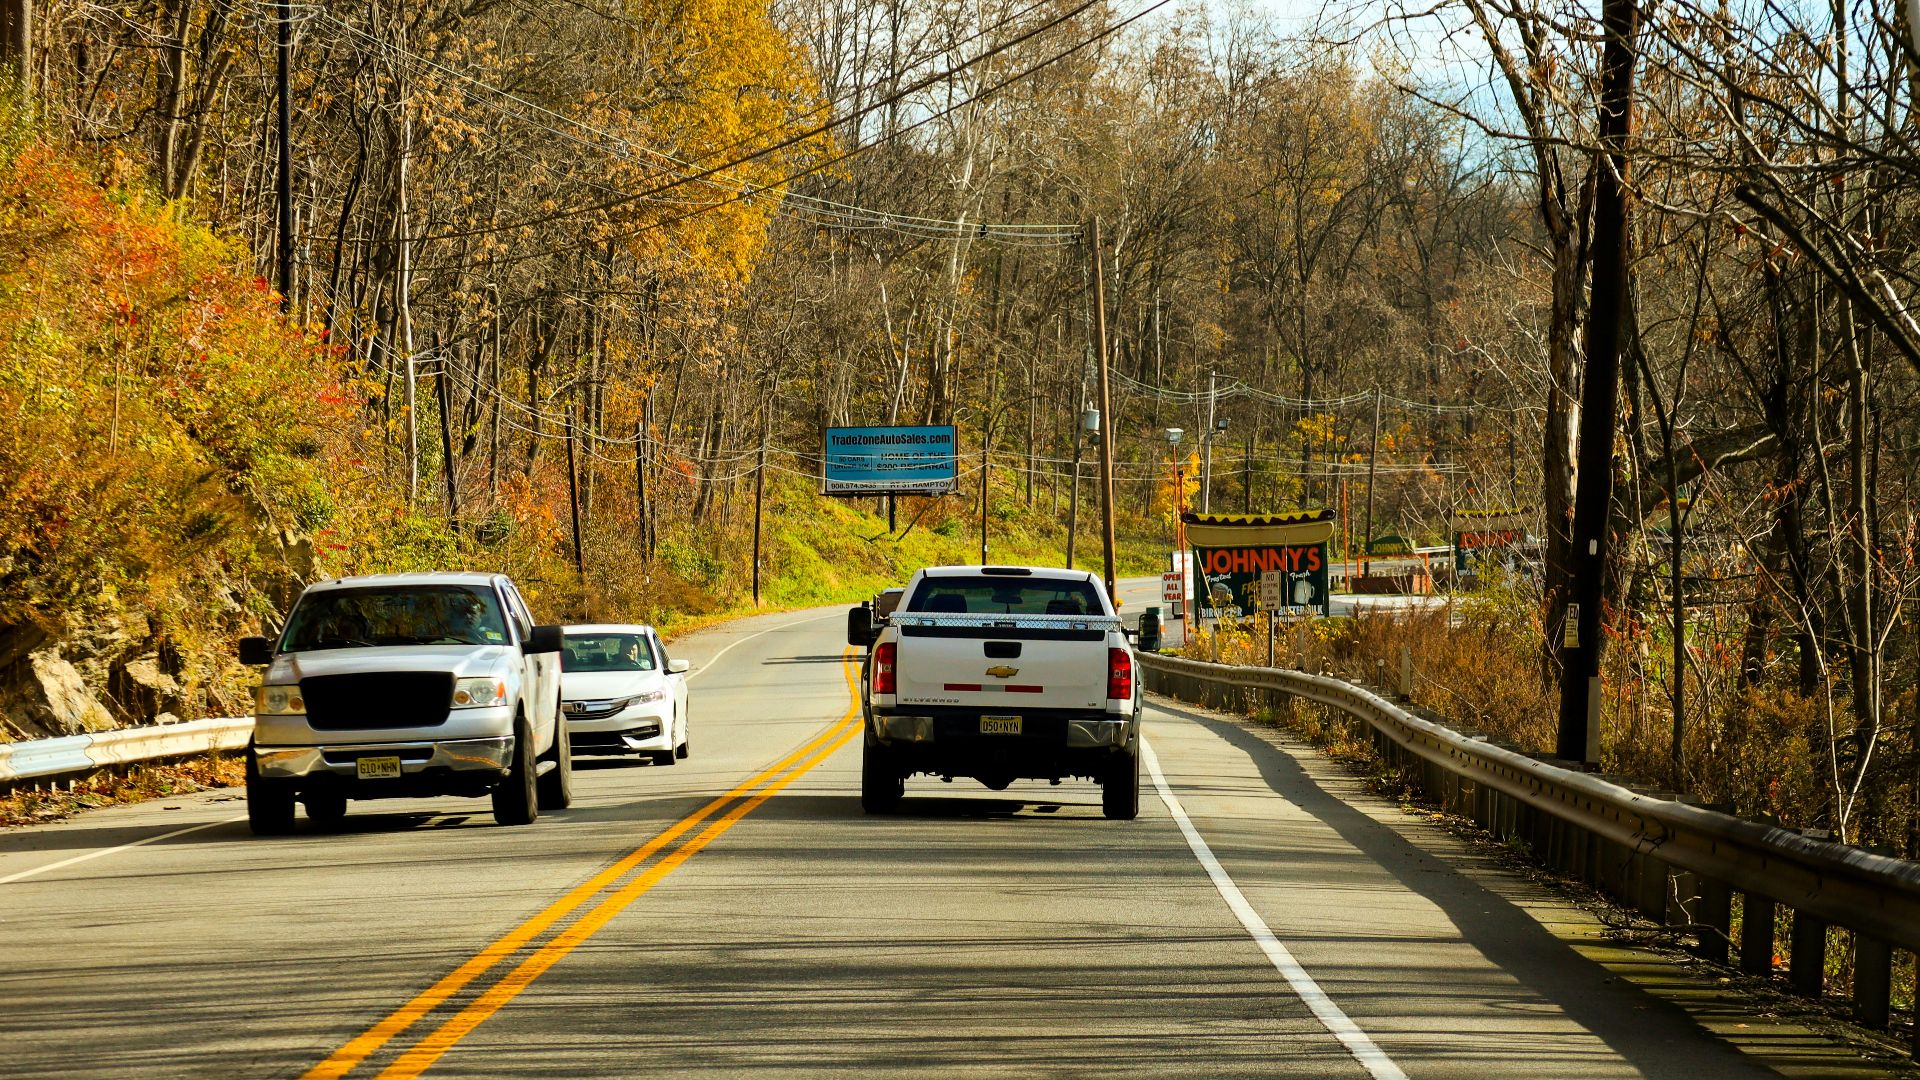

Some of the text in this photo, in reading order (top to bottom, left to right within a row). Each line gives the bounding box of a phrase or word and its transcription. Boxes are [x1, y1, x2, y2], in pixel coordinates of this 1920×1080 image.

[831, 433, 951, 446] TradeZoneAutoSales.com
[880, 451, 947, 460] HOME OF THE
[877, 462, 950, 471] $200 REFERRAL
[912, 480, 950, 488] HAMPTON
[1202, 547, 1321, 574] JOHNNY'S
[1163, 574, 1182, 582] OPEN
[1265, 573, 1275, 581] NO
[1167, 583, 1178, 591] ALL
[1164, 592, 1182, 600] YEAR
[1278, 603, 1324, 617] BUTTERILK
